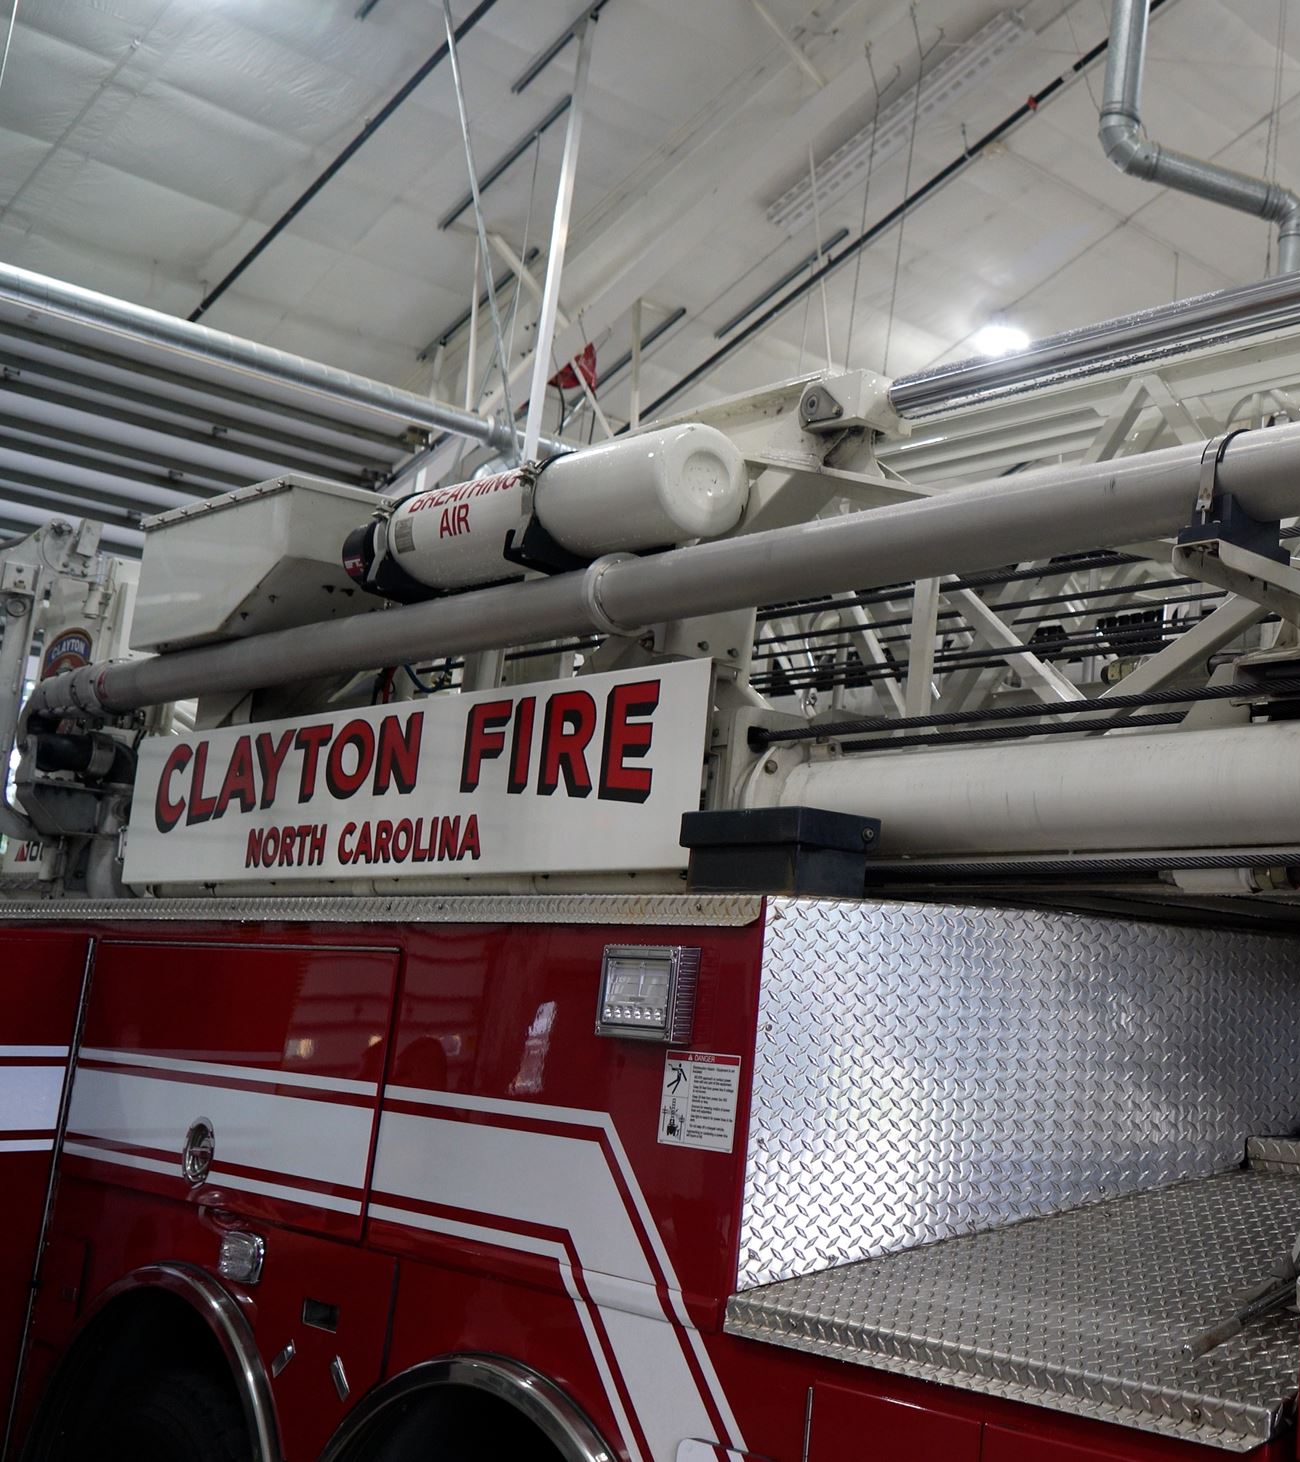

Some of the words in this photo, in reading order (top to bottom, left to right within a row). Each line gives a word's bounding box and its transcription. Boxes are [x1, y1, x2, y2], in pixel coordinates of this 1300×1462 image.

[440, 503, 471, 539] AIR
[51, 638, 87, 660] CLAYTON
[155, 711, 424, 833] CLAYTON
[460, 679, 661, 804] FIRE
[245, 823, 328, 868] NORTH
[338, 814, 481, 865] CAROLINA
[694, 1055, 716, 1063] DANGER
